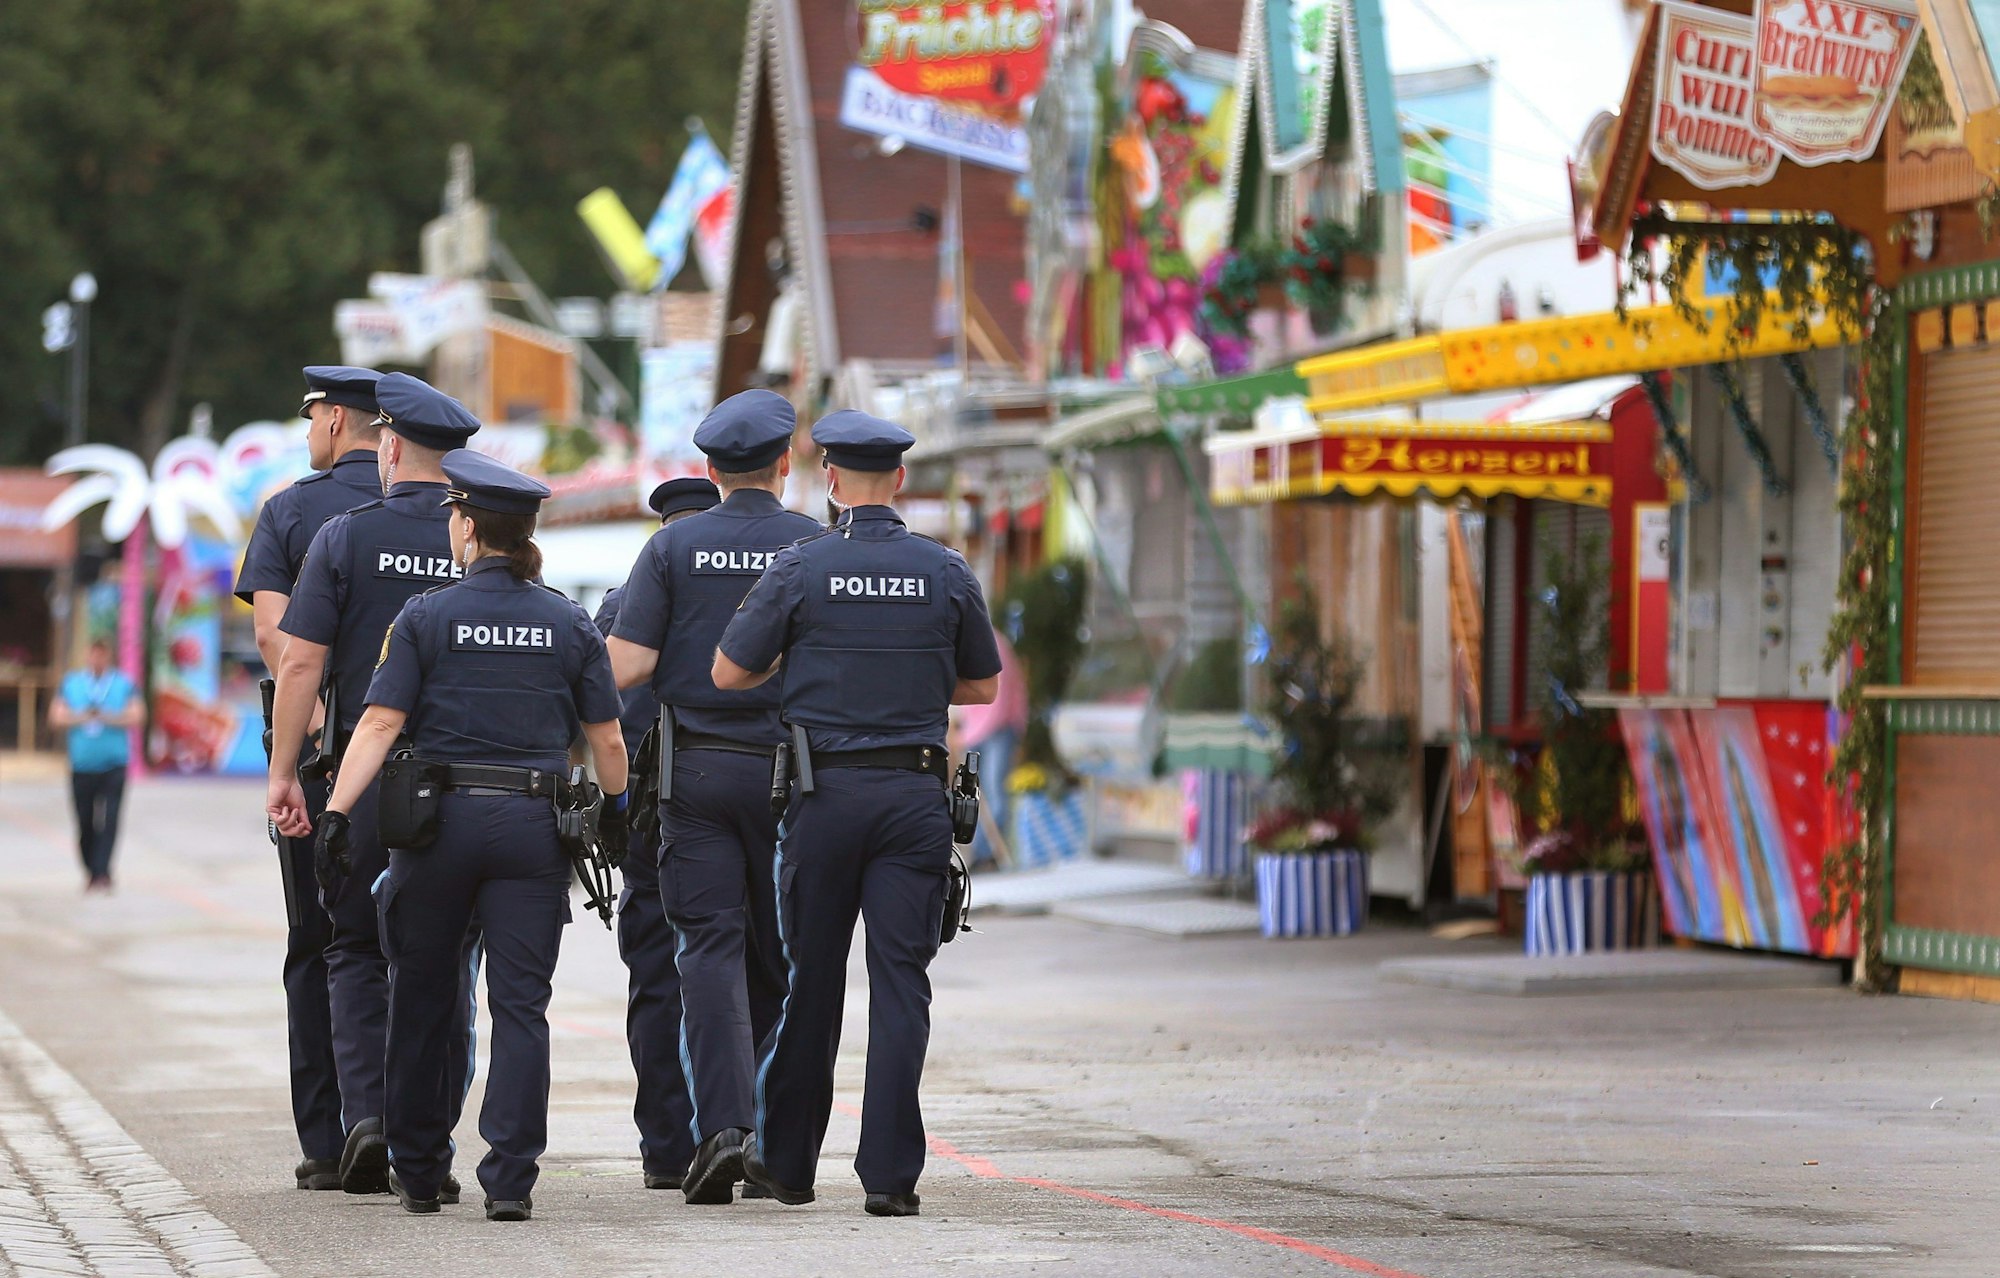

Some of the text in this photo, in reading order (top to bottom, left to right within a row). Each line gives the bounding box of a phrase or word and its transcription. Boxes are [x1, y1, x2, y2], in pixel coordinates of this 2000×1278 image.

[859, 6, 1043, 66] Früchte
[1761, 20, 1900, 89] Bratwurst
[1339, 438, 1592, 475] Herzerl
[378, 552, 468, 579] POLIZE
[695, 551, 776, 570] POLIZE
[830, 576, 925, 597] POLIZEI
[457, 625, 552, 647] POLIZEI
